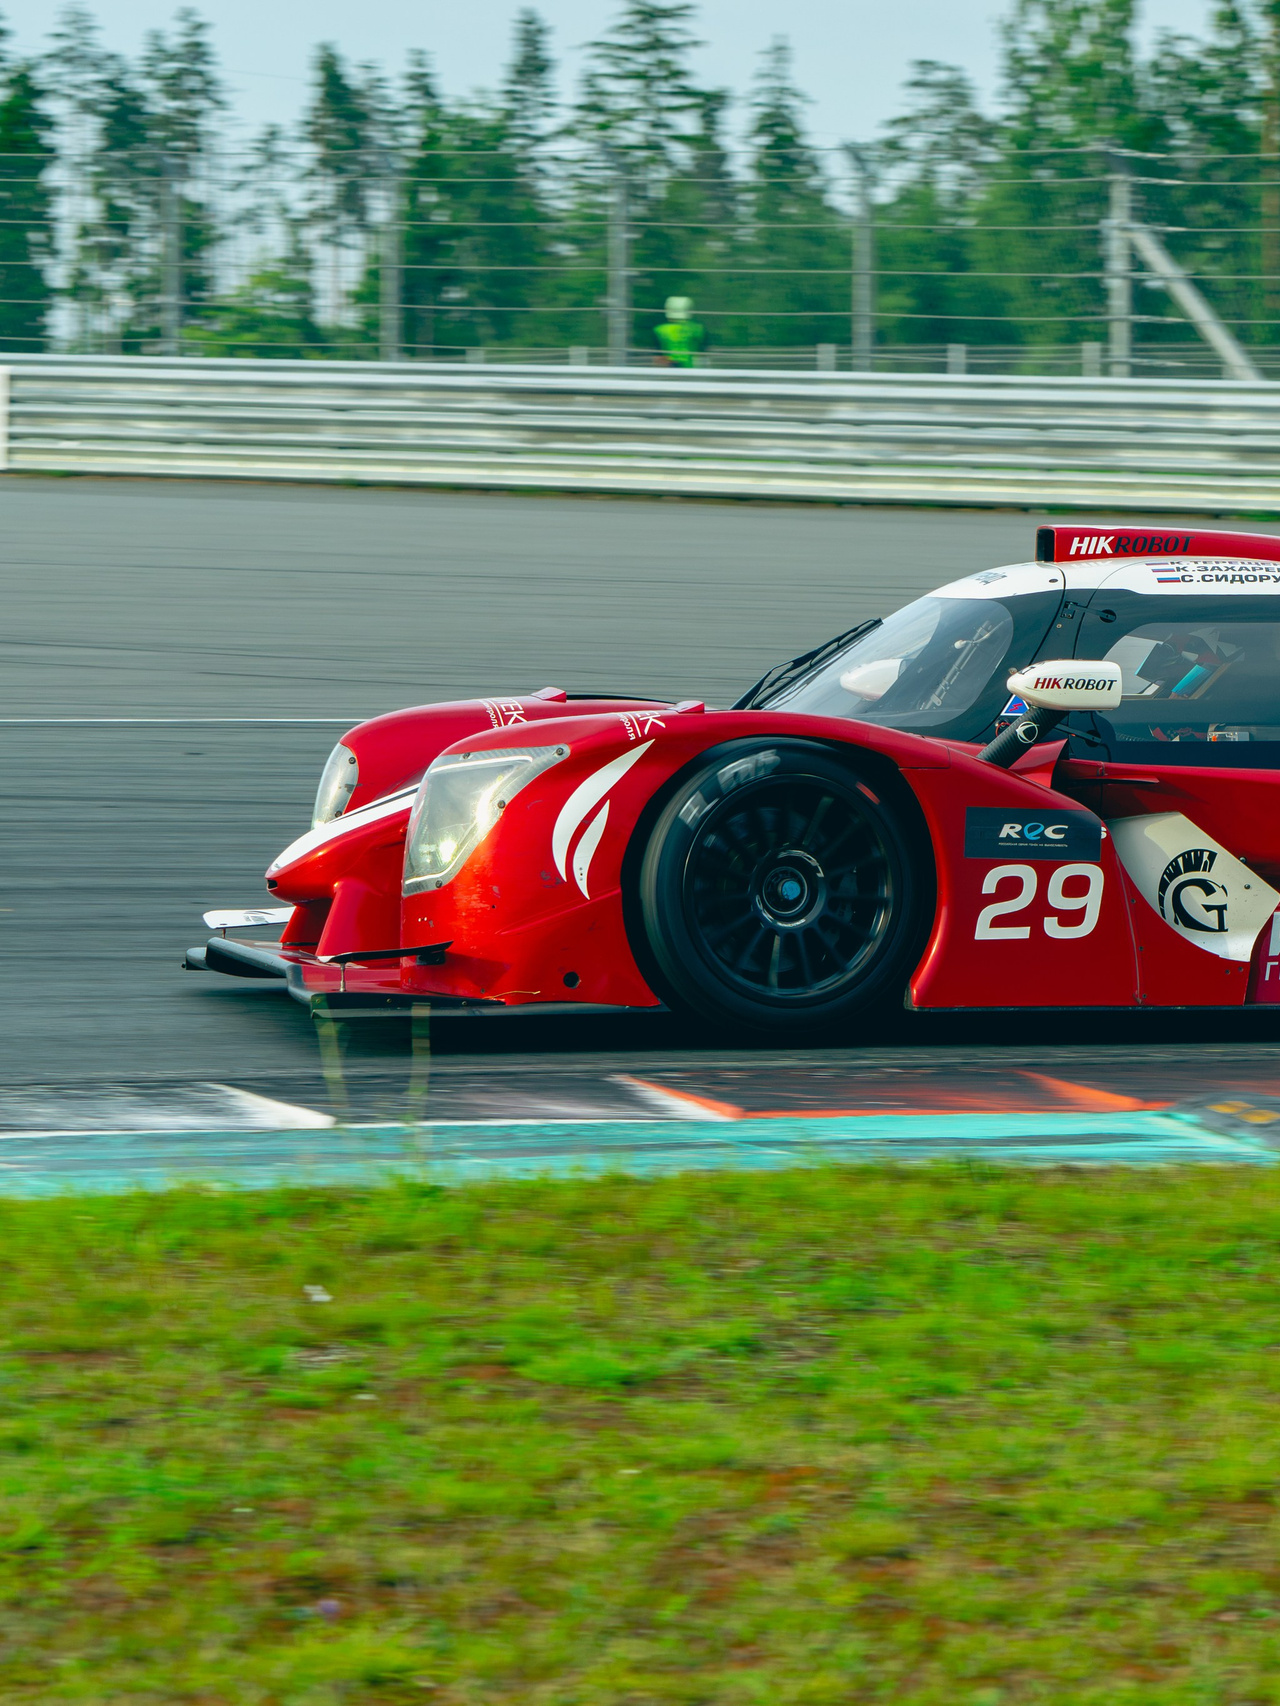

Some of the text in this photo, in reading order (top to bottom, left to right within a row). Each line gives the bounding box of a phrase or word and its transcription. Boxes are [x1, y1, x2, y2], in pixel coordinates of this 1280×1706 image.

[1069, 536, 1195, 555] HIKROBOT
[1034, 677, 1118, 691] HIKROBOT
[974, 863, 1105, 941] 29
